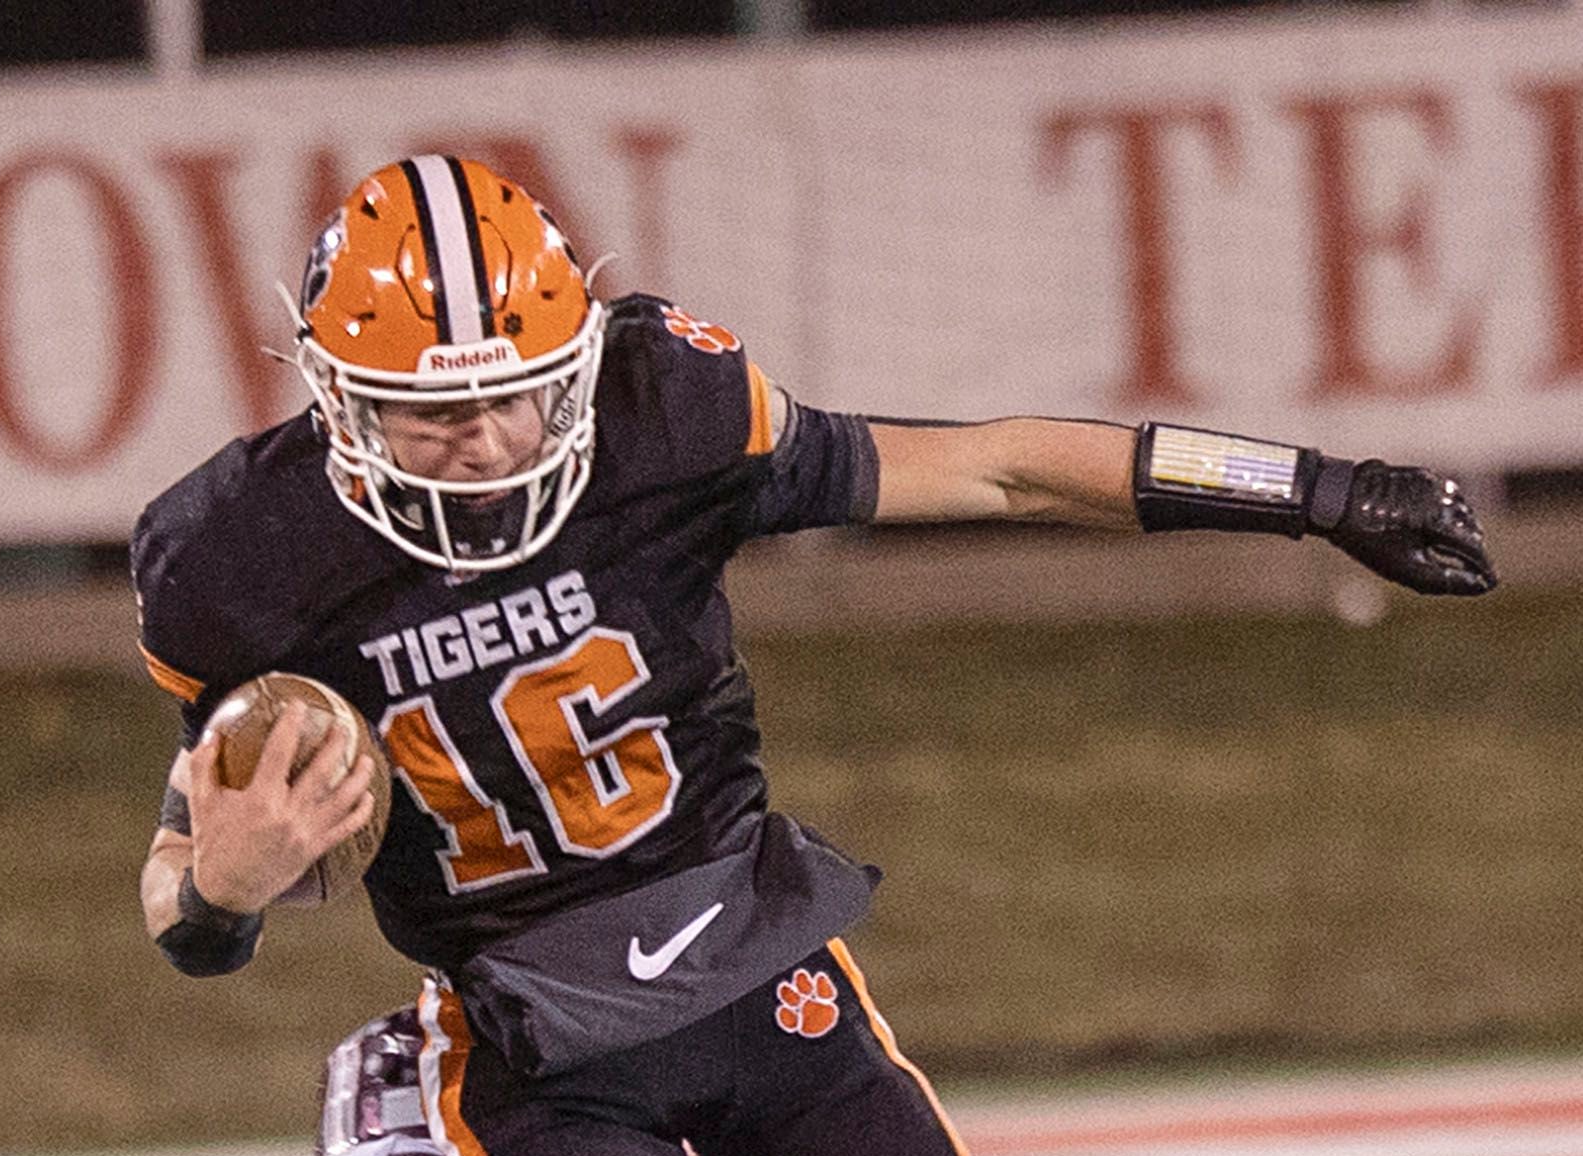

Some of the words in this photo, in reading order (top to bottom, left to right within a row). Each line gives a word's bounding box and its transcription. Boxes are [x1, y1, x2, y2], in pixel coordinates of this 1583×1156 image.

[430, 345, 508, 371] Riddell
[359, 569, 597, 695] TIGERS
[379, 626, 683, 895] 16
